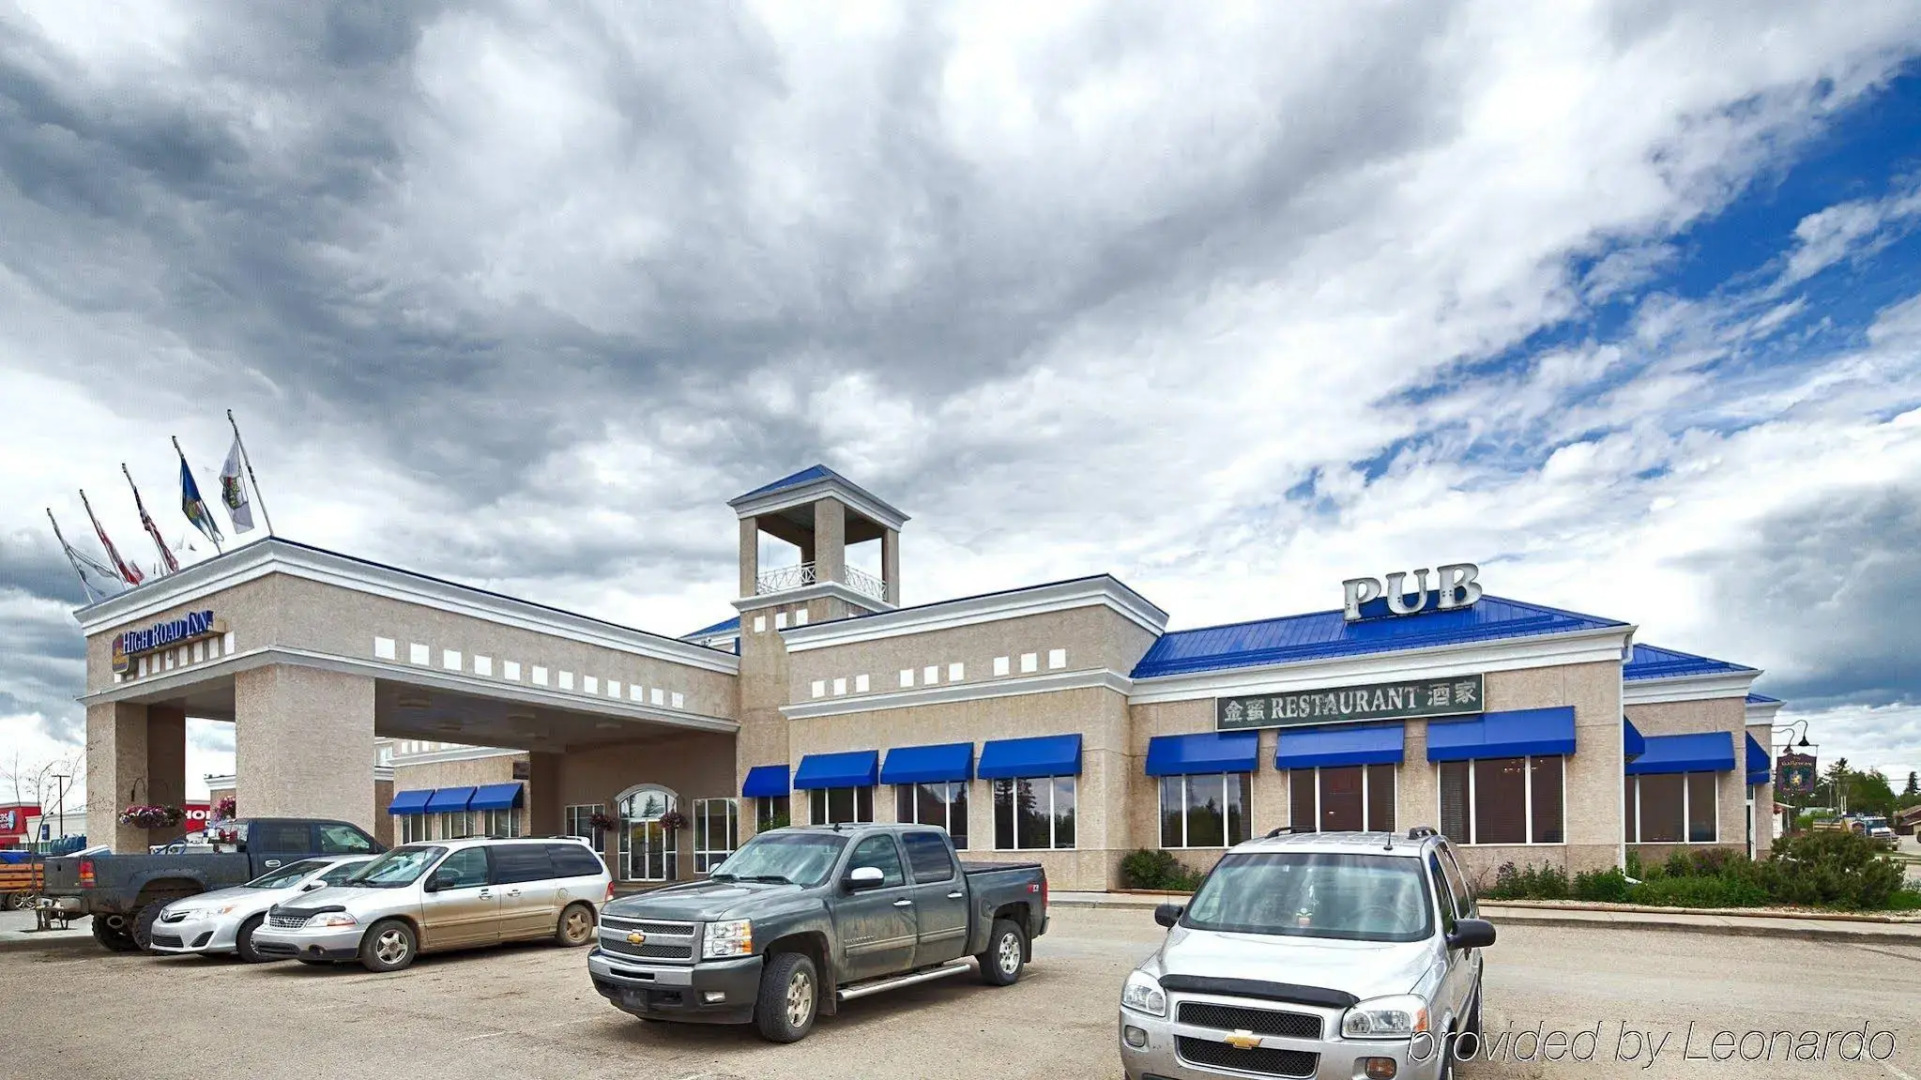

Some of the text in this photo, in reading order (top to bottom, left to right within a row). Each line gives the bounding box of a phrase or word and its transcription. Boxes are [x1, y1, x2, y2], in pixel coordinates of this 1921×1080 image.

[1342, 562, 1483, 621] PUB
[123, 611, 210, 654] HIGH ROAD INN
[1270, 686, 1420, 719] RESTAURANT
[1427, 681, 1477, 707] 酒家
